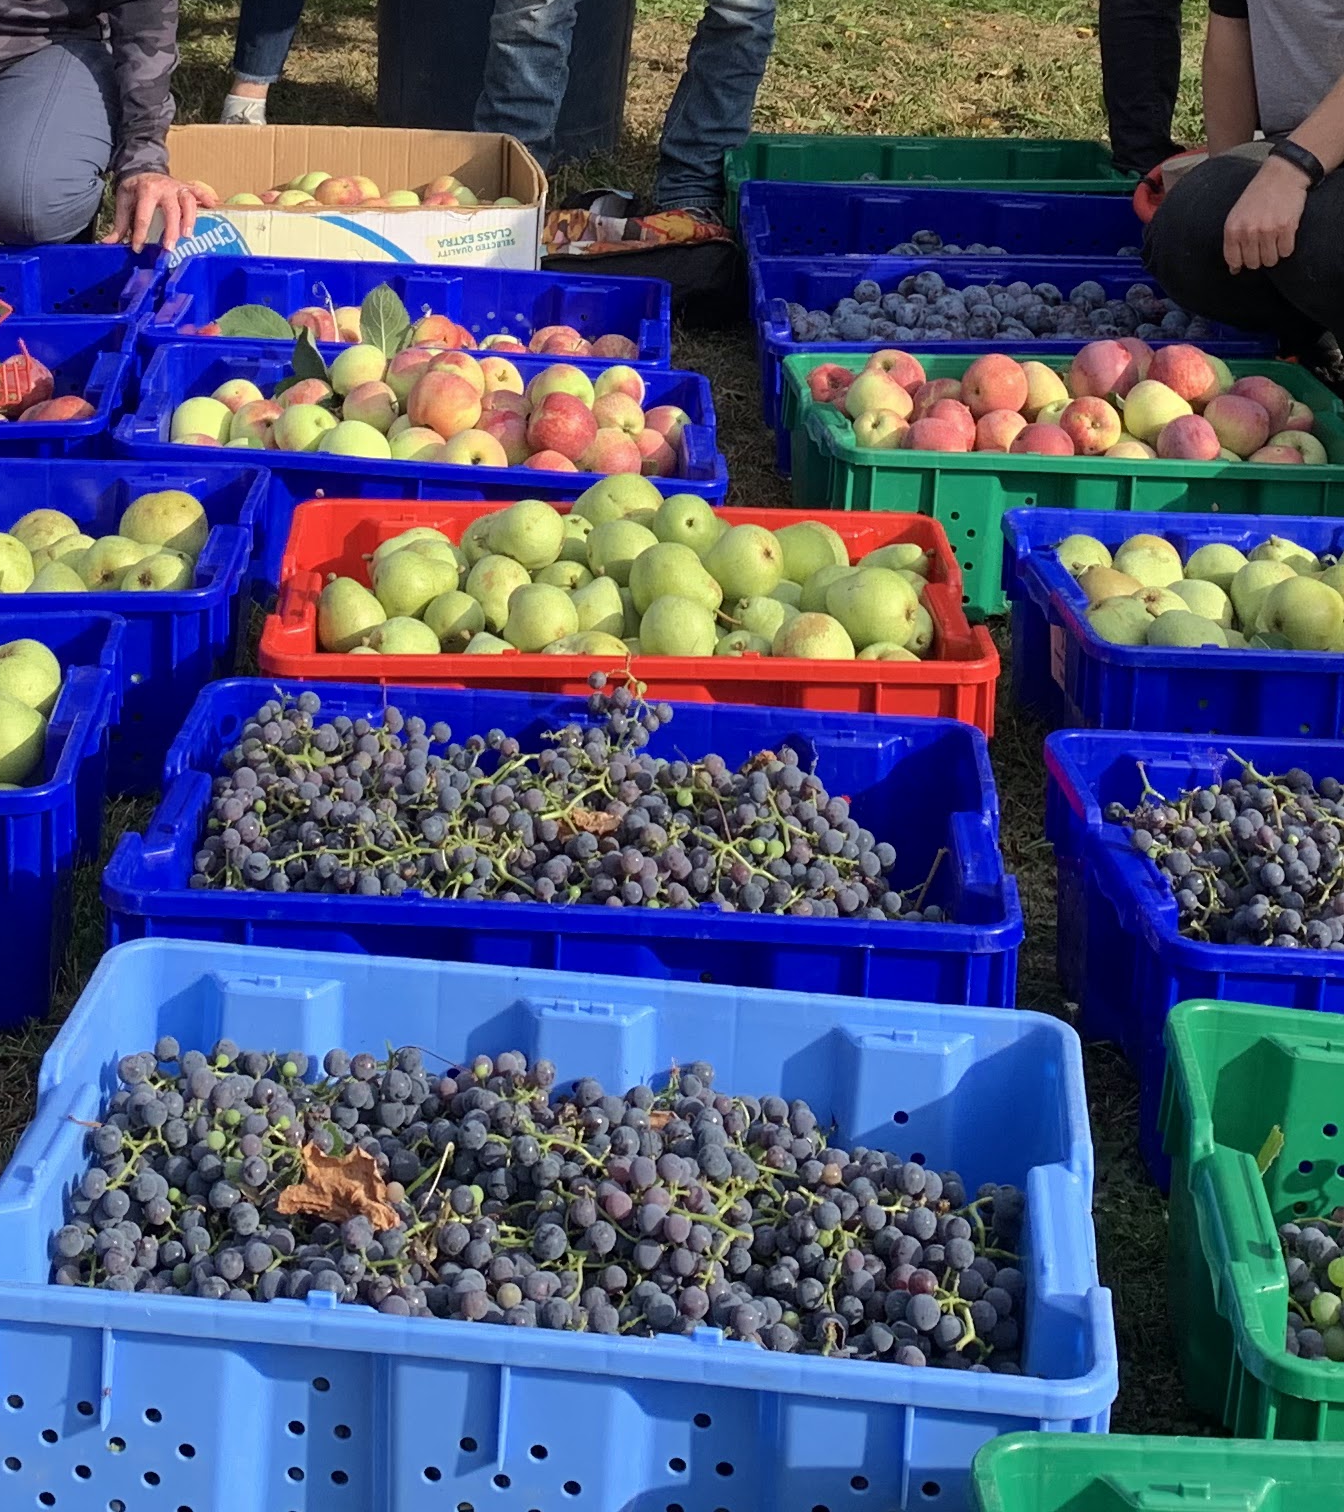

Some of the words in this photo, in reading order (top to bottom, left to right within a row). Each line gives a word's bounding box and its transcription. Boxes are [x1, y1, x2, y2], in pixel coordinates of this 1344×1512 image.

[437, 234, 474, 248] EXTRA
[477, 228, 512, 242] CLASS
[476, 238, 516, 251] SELECTED
[437, 245, 473, 258] QUALITY
